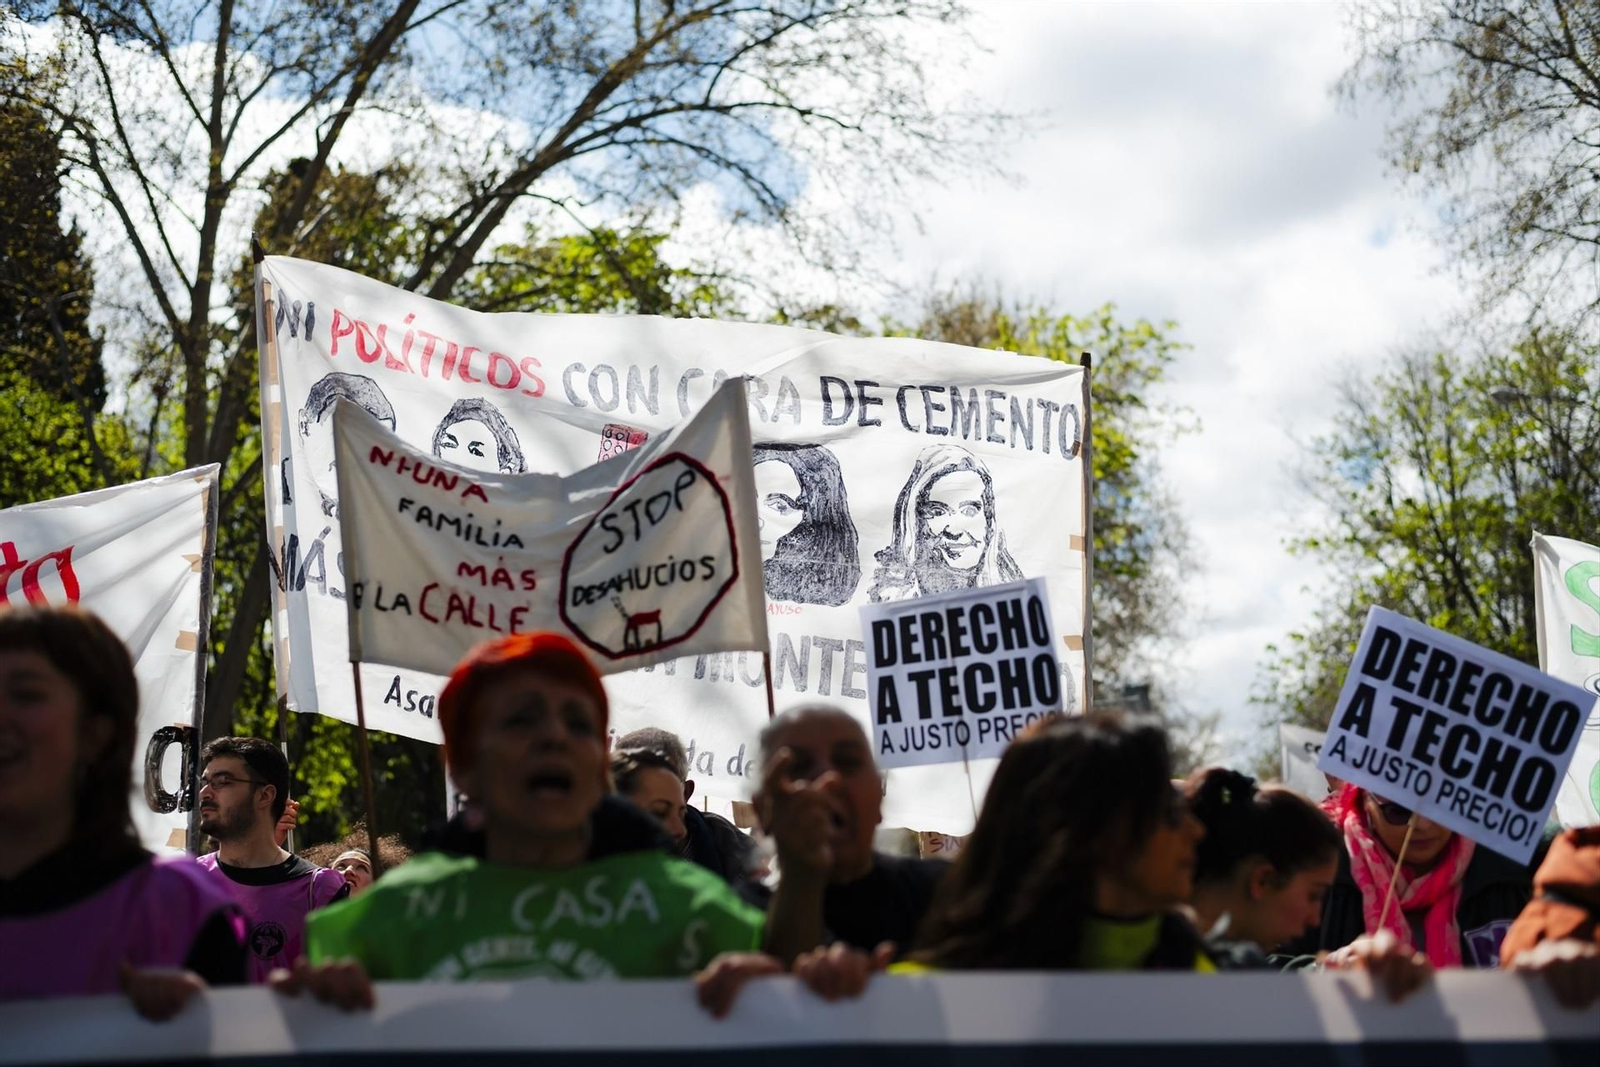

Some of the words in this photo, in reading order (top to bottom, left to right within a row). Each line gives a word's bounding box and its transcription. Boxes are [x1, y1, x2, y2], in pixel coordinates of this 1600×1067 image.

[329, 308, 546, 398] POLÍTICOS
[562, 362, 660, 416] CON
[677, 368, 802, 425] CRA
[820, 376, 884, 427] DE
[896, 384, 1081, 461] CEMENTO
[601, 468, 697, 554] STOP
[375, 585, 412, 616] LA
[457, 556, 537, 591] MÁS
[766, 603, 803, 616] AYUSO
[871, 595, 1050, 669] DERECHO
[877, 675, 902, 725] A
[907, 653, 1060, 720] TECHO
[1360, 625, 1581, 756] DERECHO
[880, 729, 895, 755] A
[900, 719, 970, 753] JUSTO
[1338, 682, 1377, 739] A
[1386, 696, 1557, 813] TECHO
[1328, 734, 1346, 763] A
[1352, 745, 1432, 797] JUSTO
[1435, 778, 1538, 847] PRECIO!
[511, 874, 660, 932] CASA
